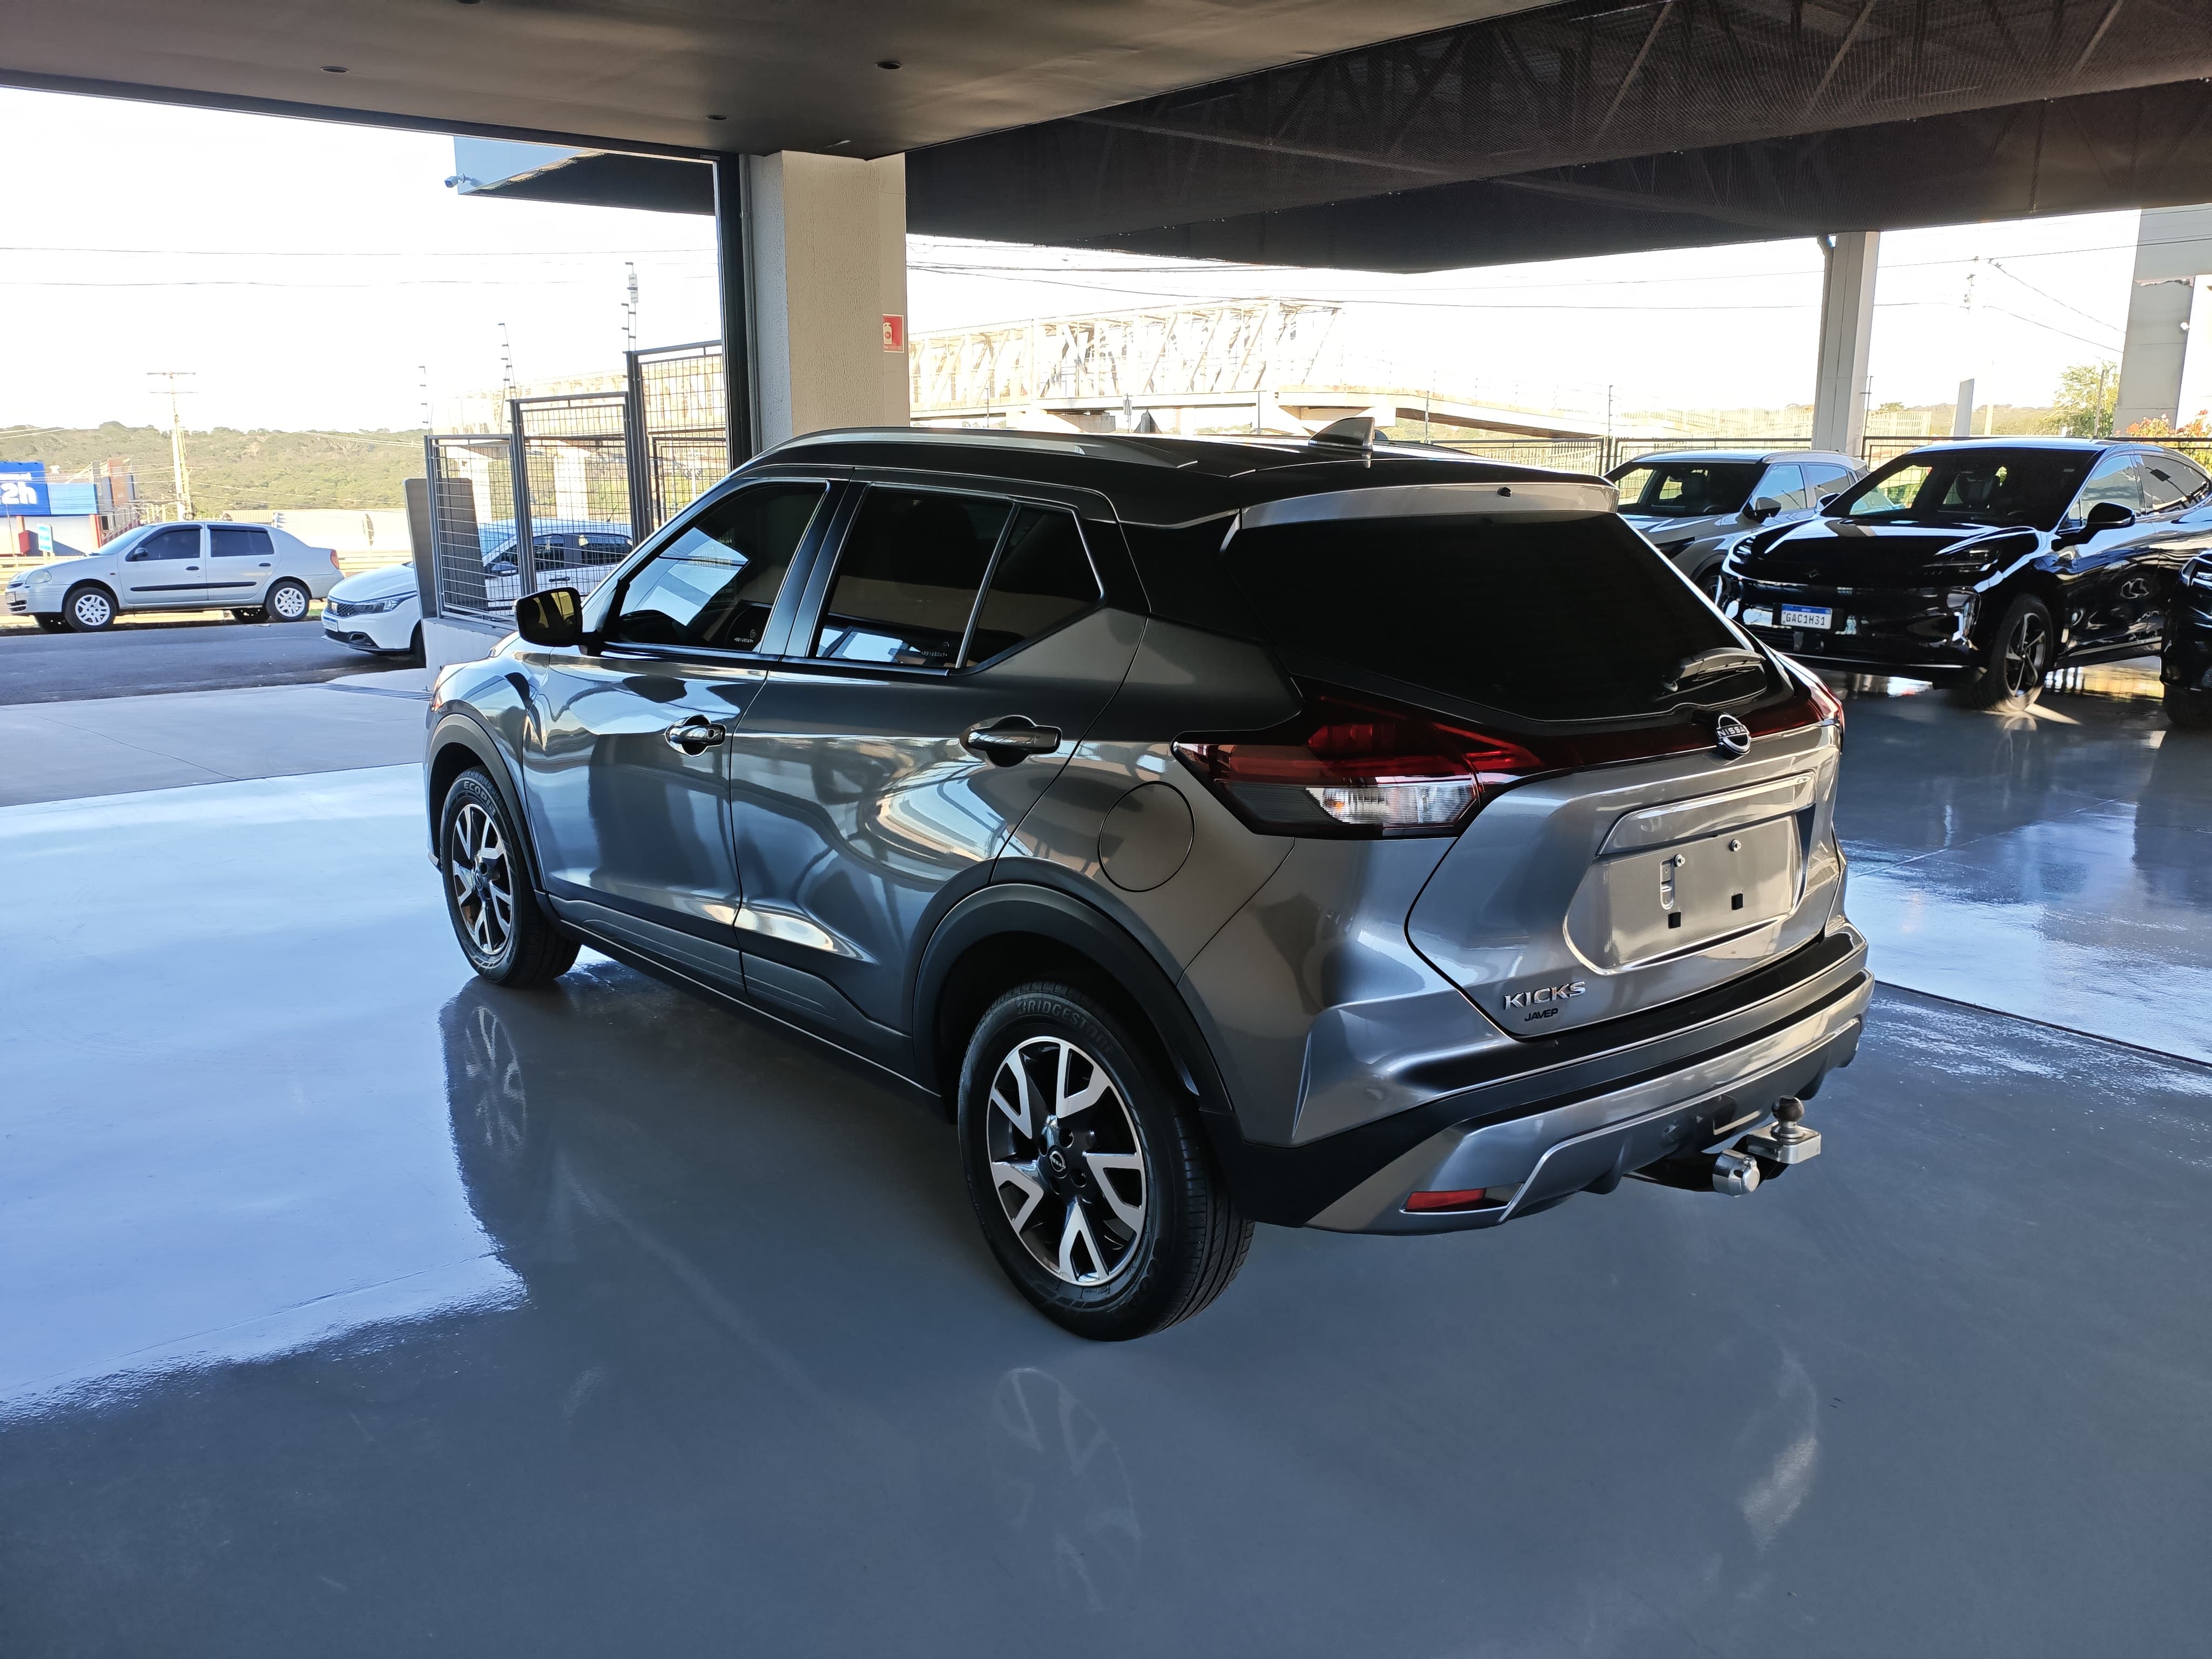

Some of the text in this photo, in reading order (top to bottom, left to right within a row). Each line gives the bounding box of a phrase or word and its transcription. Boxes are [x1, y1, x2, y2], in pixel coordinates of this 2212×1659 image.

[0, 481, 37, 504] 2h
[1786, 613, 1825, 625] GAC1H31
[1716, 725, 1746, 737] NISSA
[1503, 981, 1586, 1010] KICKS
[1524, 1008, 1559, 1022] JAVEP
